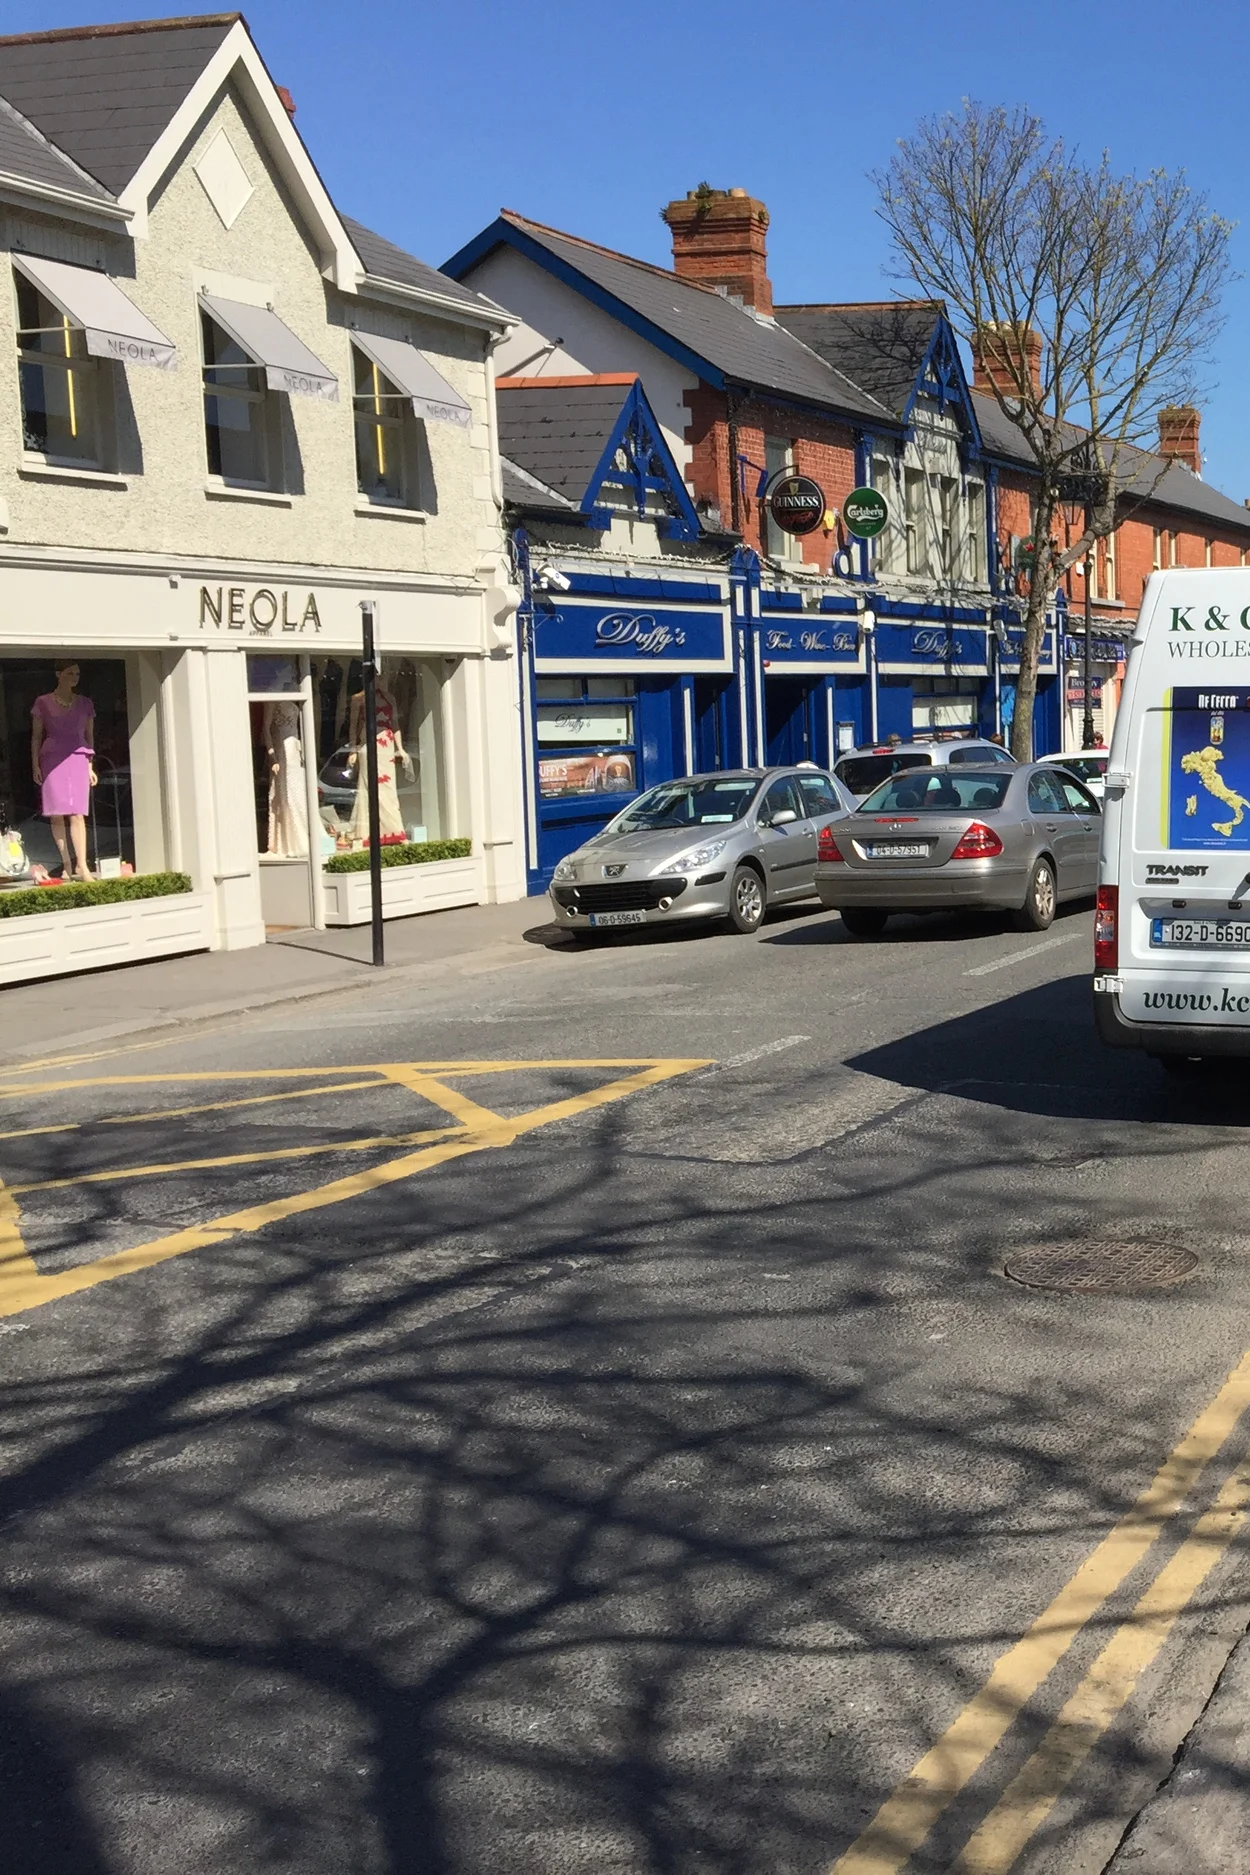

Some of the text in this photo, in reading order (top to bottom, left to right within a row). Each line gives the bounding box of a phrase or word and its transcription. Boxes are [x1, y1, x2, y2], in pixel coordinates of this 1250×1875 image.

[107, 339, 157, 362] NEOLA
[283, 374, 324, 394] NEOLA
[426, 404, 461, 421] NEOLA
[773, 495, 820, 508] GUINNESS
[847, 504, 884, 521] Carlsberg
[199, 586, 321, 633] NEOLA
[1168, 606, 1196, 632] K
[1204, 605, 1231, 631] &
[595, 612, 686, 654] Duffy's
[554, 713, 591, 734] Duffy's
[539, 764, 567, 778] UFFY'S
[1146, 864, 1209, 876] TRANSIT
